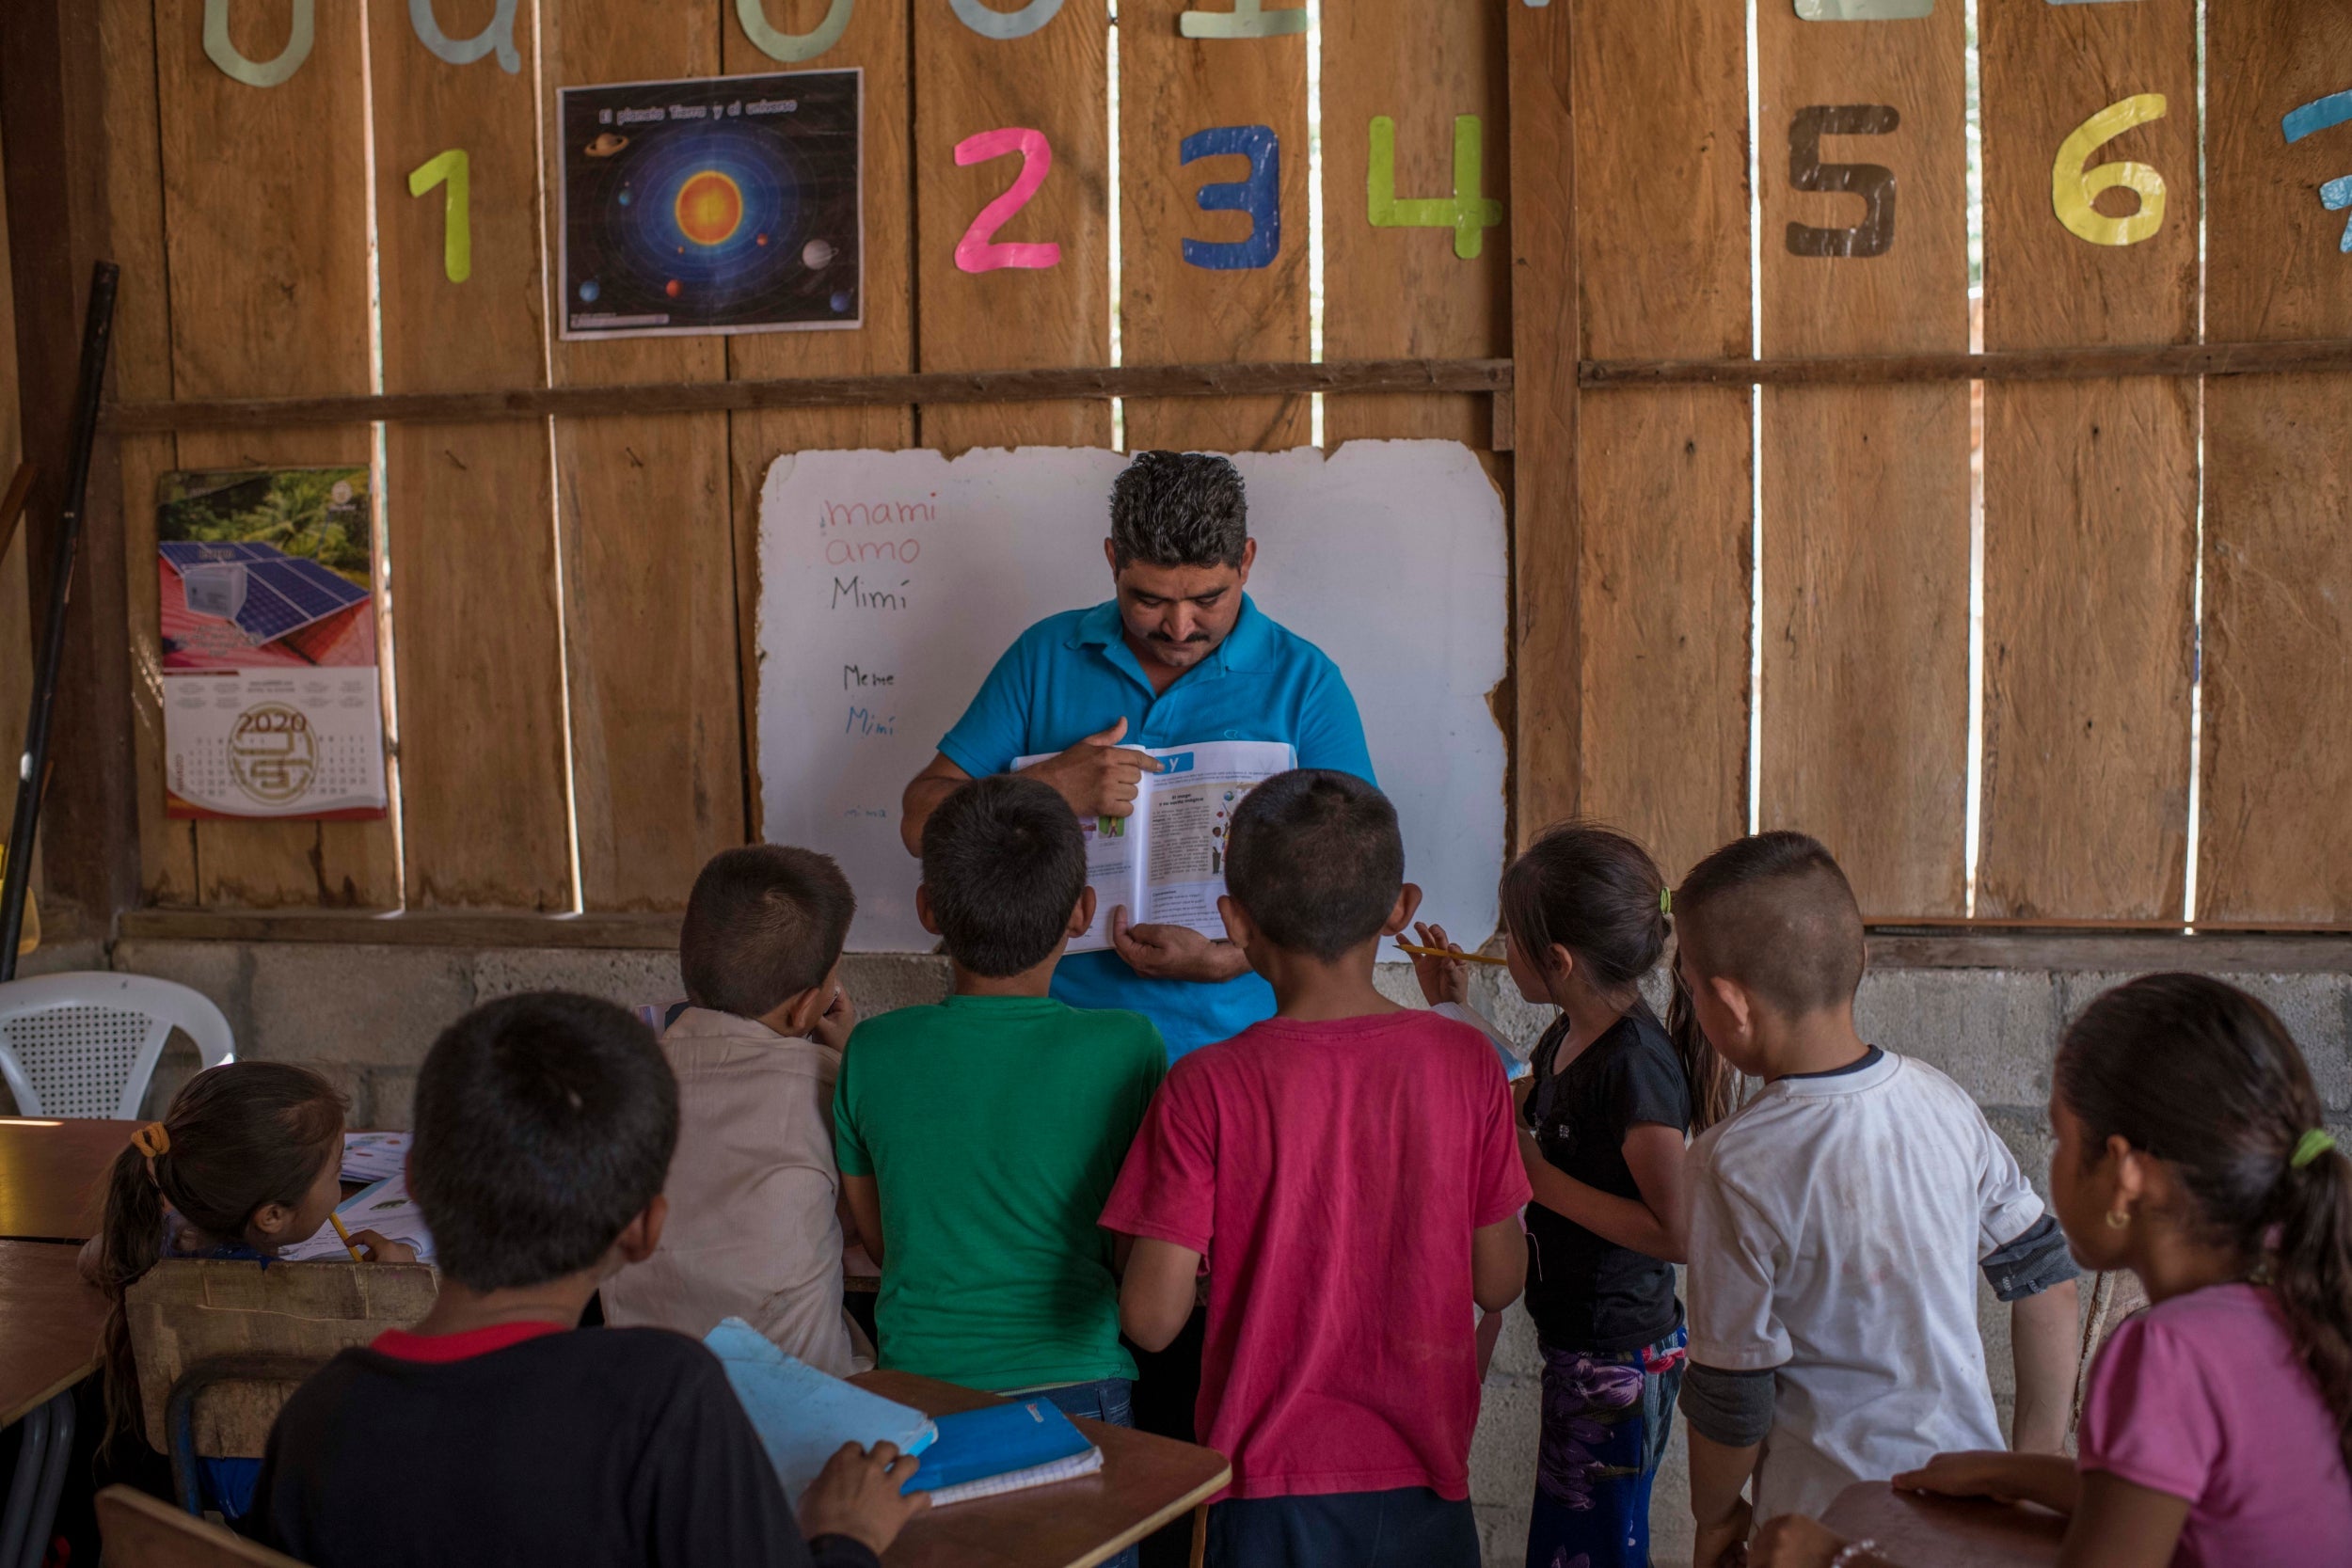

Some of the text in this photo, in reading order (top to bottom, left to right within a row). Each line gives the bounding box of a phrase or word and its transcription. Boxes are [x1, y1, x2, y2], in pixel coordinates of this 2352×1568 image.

[669, 104, 706, 119] Tierra
[712, 104, 724, 120] y
[746, 99, 798, 115] universo
[409, 150, 469, 282] 1
[954, 127, 1060, 273] 2
[1181, 125, 1279, 269] 3
[1368, 115, 1502, 259] 4
[1786, 104, 1900, 257] 5
[2052, 93, 2167, 245] 6
[824, 491, 937, 526] mami
[826, 538, 920, 565] amo
[831, 576, 910, 610] Mimí
[844, 664, 895, 691] Meme
[238, 711, 307, 734] 2020
